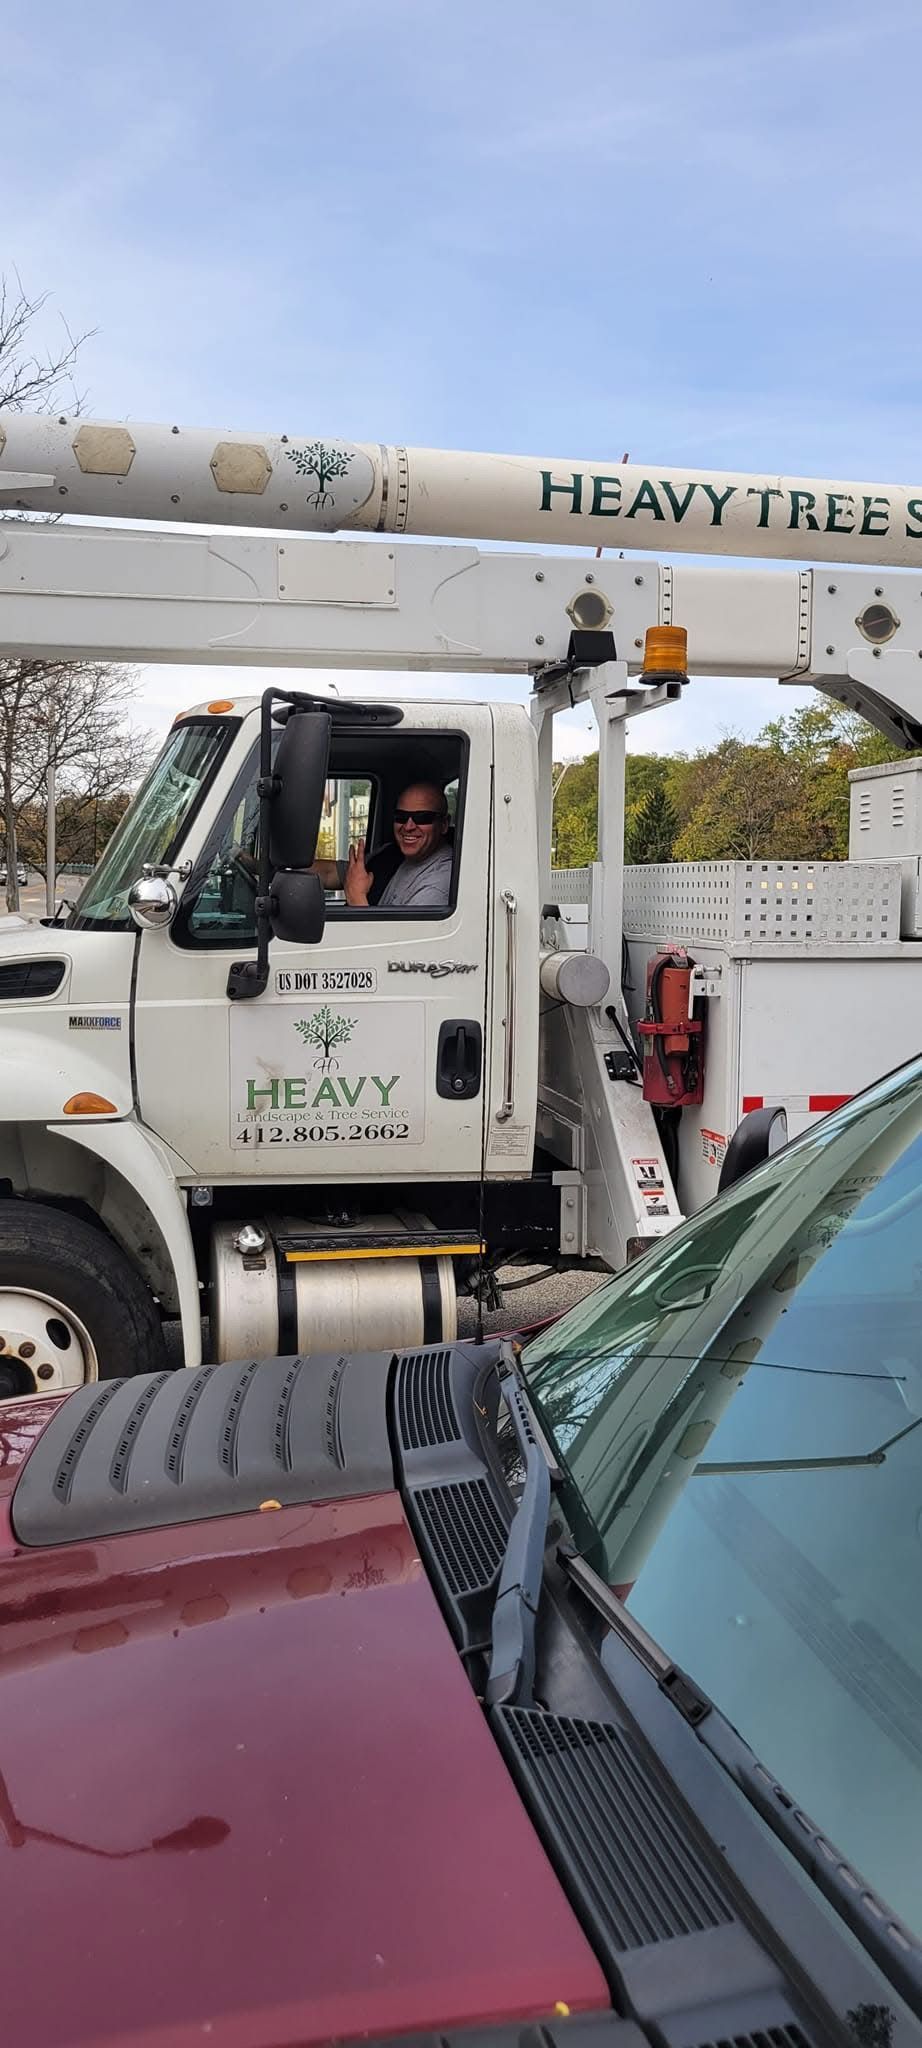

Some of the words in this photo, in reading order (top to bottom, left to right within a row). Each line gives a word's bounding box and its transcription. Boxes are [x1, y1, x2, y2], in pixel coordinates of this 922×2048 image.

[539, 471, 738, 526] HEAVY
[747, 488, 891, 536] TREE
[279, 973, 291, 990] US
[295, 973, 318, 990] DOT
[322, 972, 373, 989] 3527028
[246, 1076, 400, 1110] HEAVY
[237, 1112, 311, 1123] Landscape
[315, 1111, 324, 1120] &
[328, 1110, 358, 1120] Tree
[361, 1108, 409, 1119] Service
[236, 1123, 409, 1143] 412.805.2662
